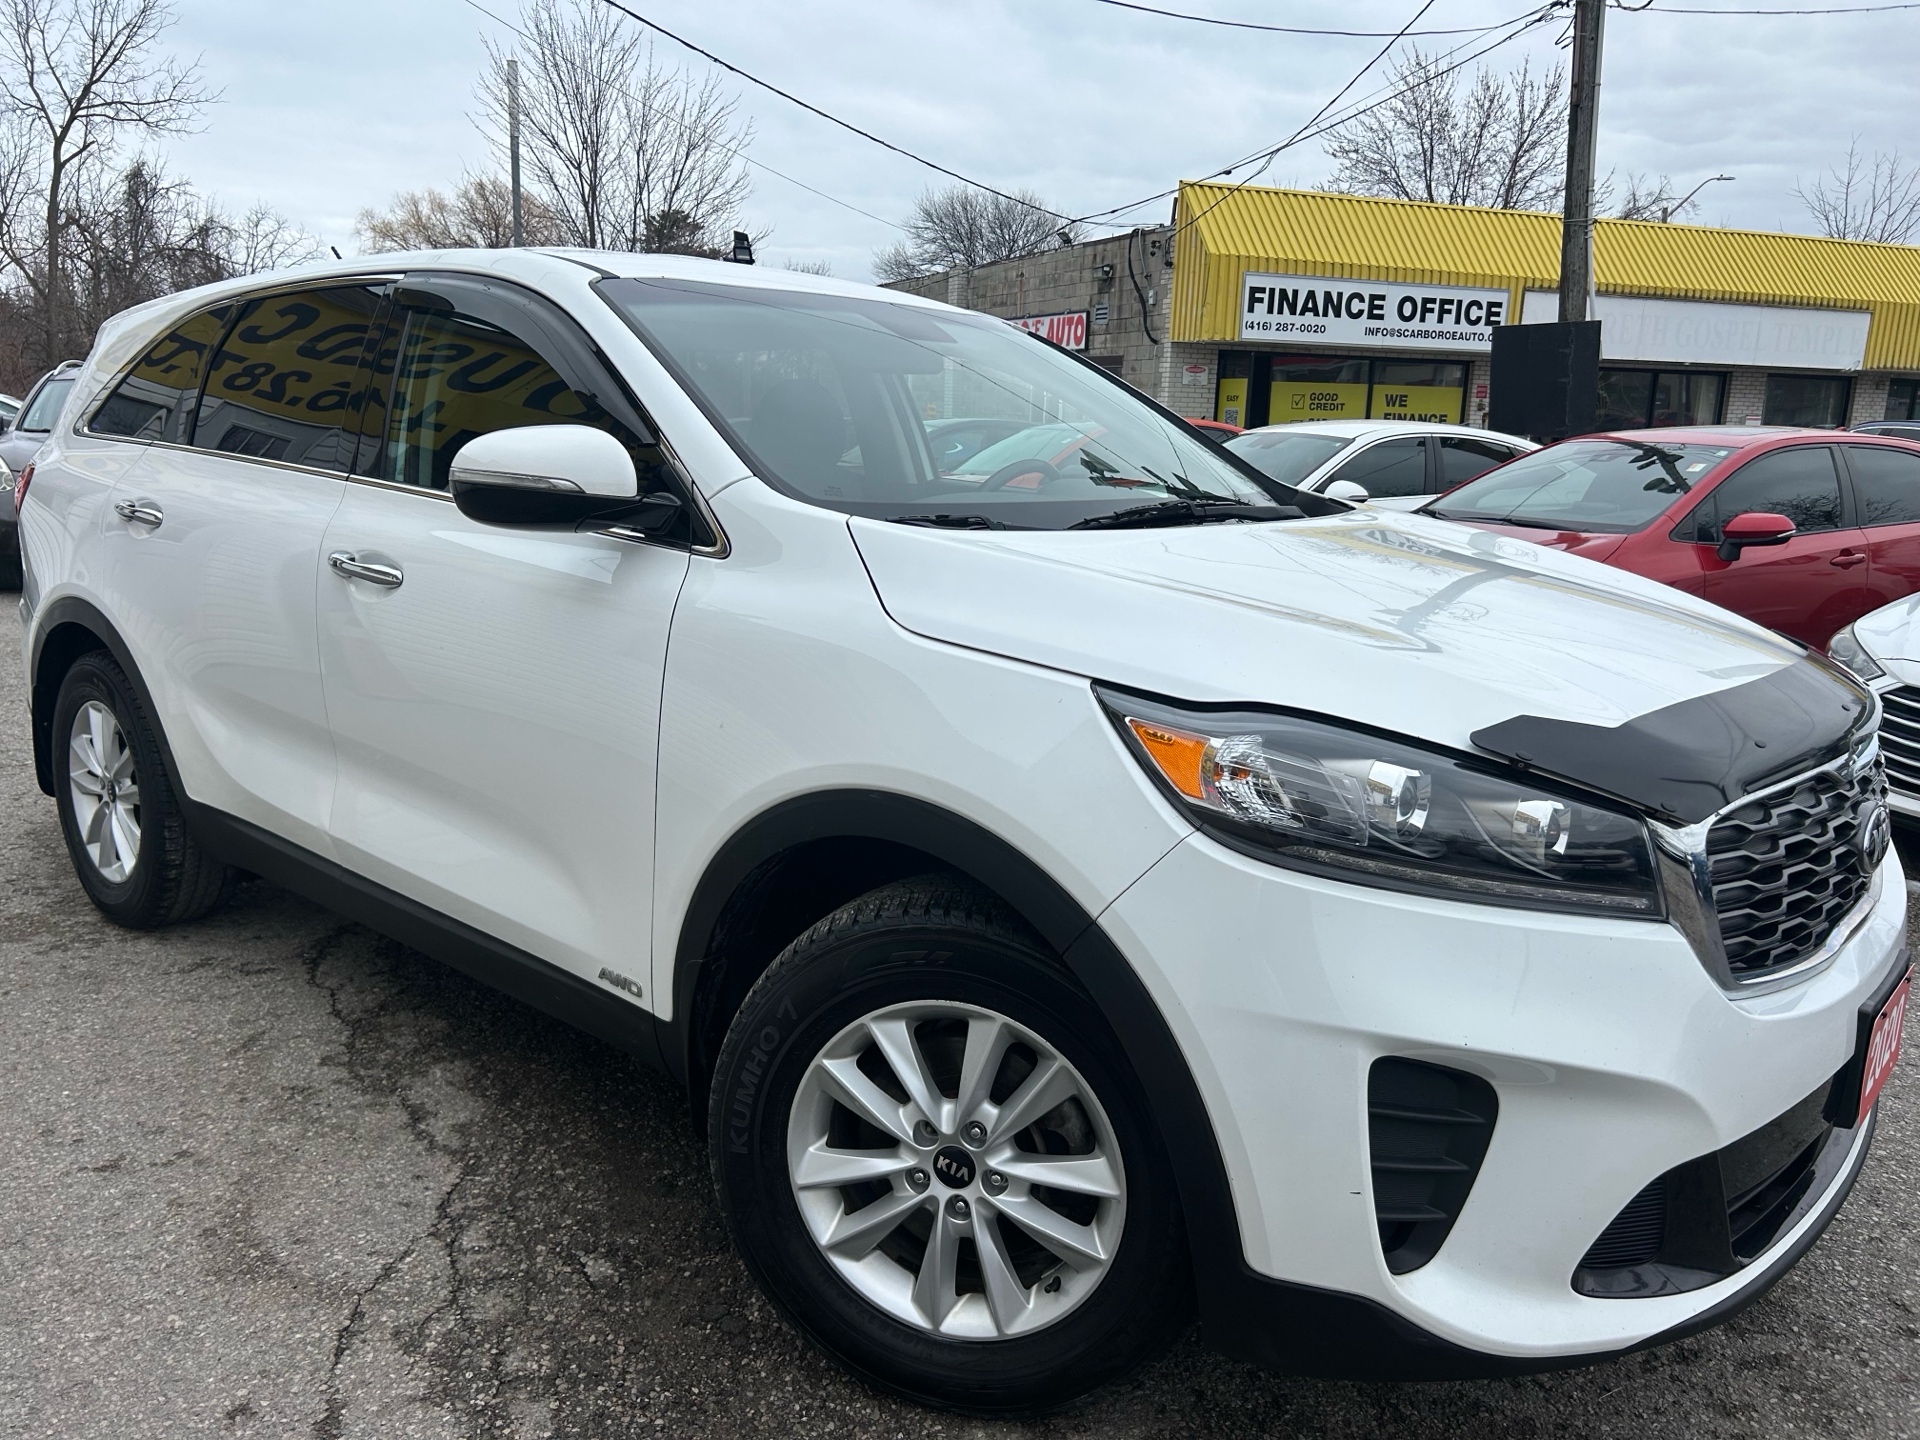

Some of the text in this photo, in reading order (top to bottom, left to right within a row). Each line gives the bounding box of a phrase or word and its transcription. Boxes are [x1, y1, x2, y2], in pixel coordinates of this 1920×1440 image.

[1247, 286, 1503, 326] FINANCE OFFICE
[1047, 314, 1085, 347] AUTO
[1245, 321, 1327, 334] (416) 287-0020
[1226, 394, 1239, 402] EASY
[1308, 402, 1346, 412] CREDIT
[1309, 392, 1338, 402] GOOD
[1385, 393, 1409, 408] WE
[598, 967, 643, 997] AWD
[1865, 993, 1906, 1097] 2020
[728, 1025, 780, 1154] KUMHO
[936, 1154, 969, 1181] KIA
